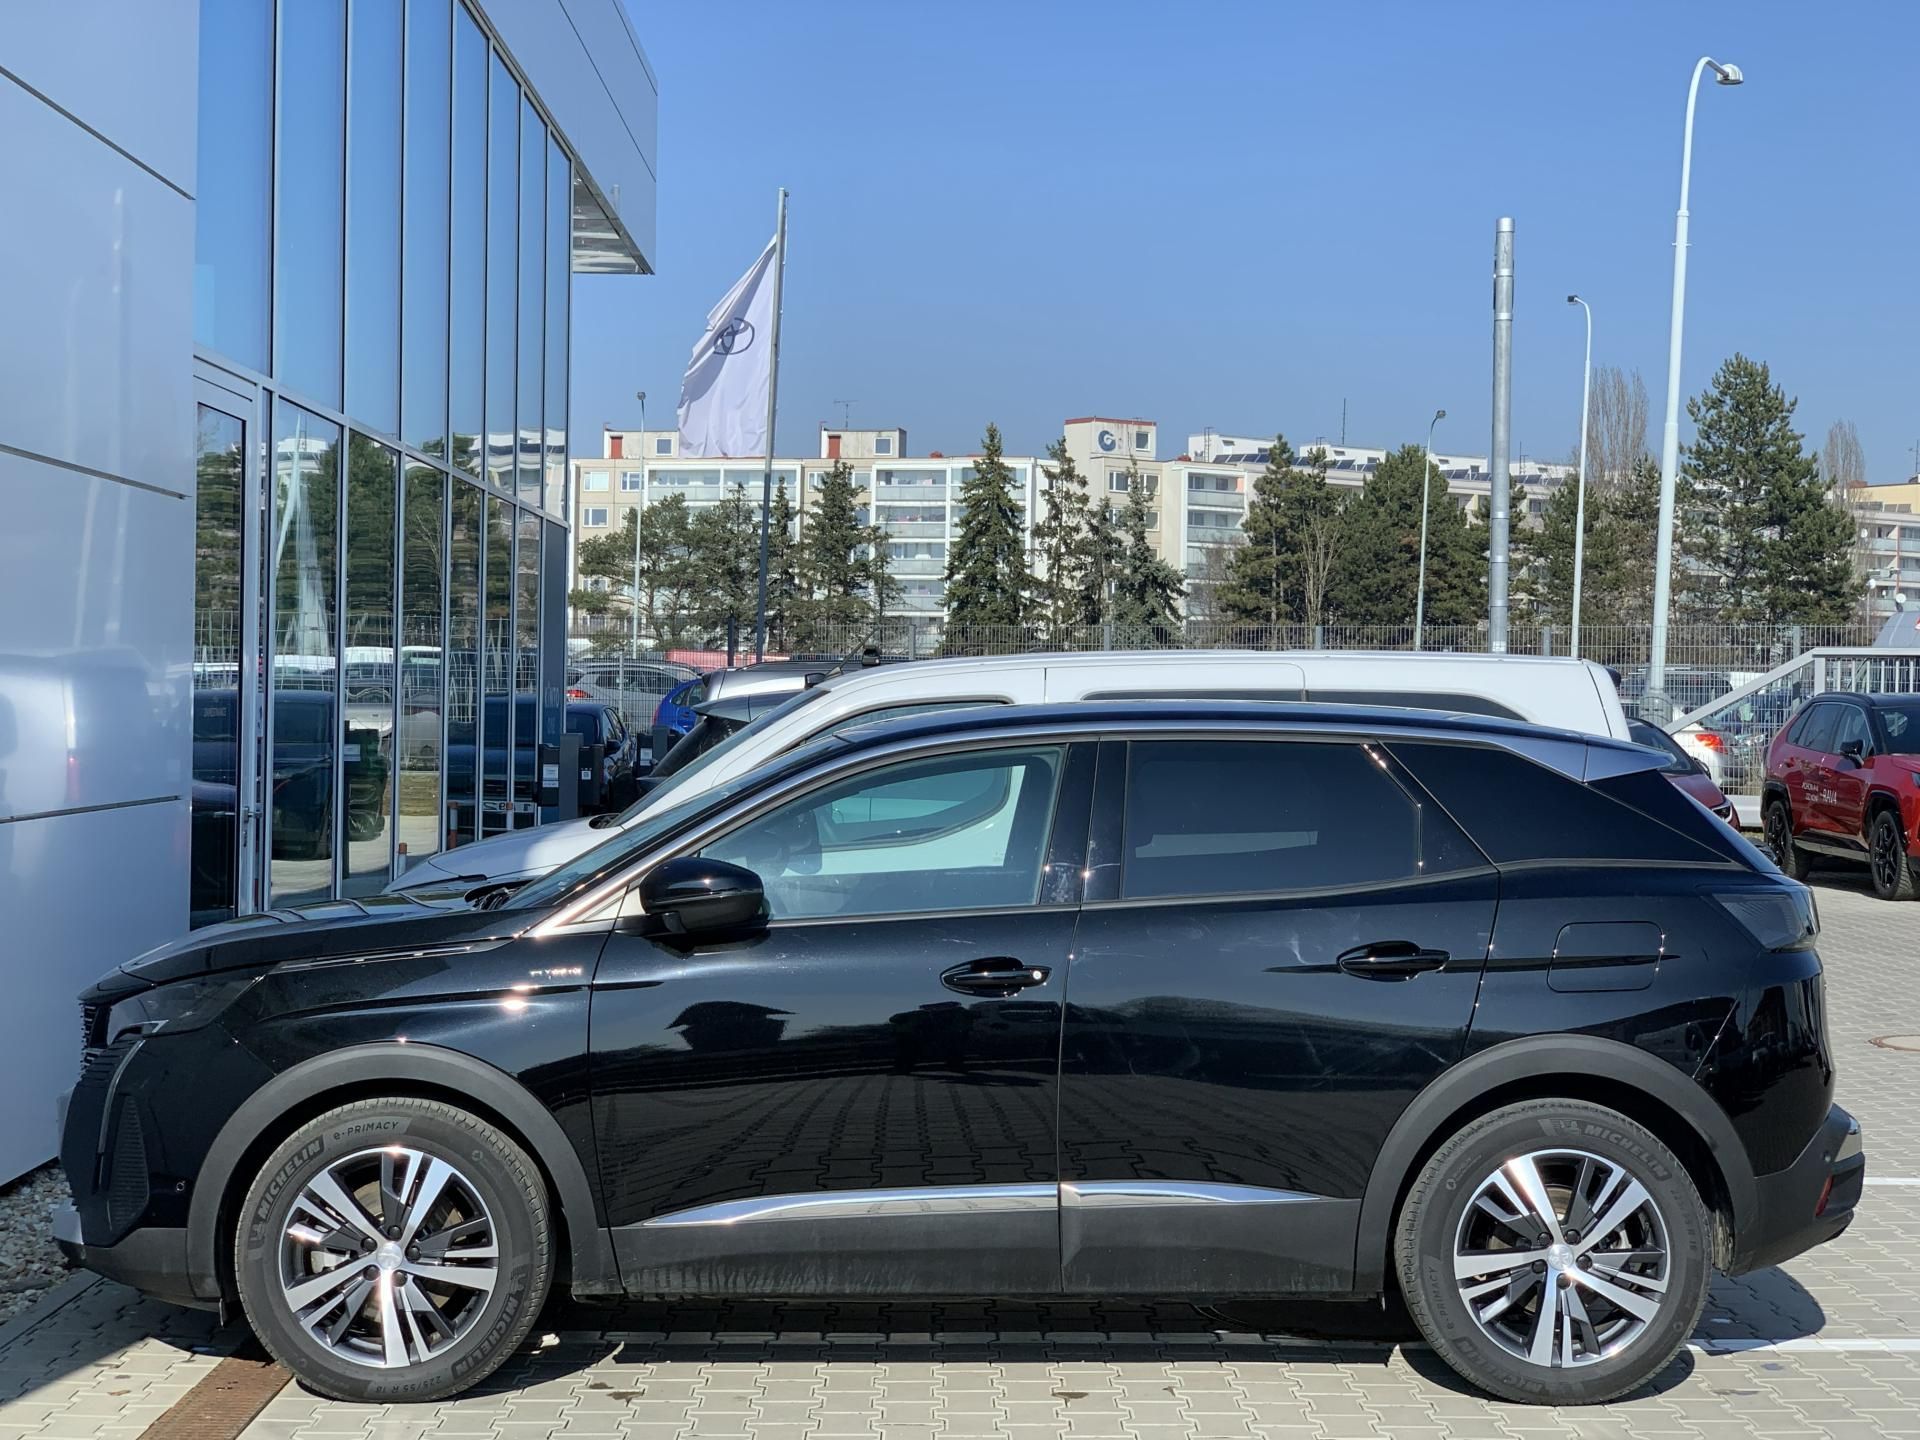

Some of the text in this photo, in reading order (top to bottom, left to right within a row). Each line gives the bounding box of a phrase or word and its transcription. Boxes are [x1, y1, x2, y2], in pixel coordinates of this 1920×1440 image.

[257, 1138, 322, 1221] MICHELIN
[1584, 1124, 1669, 1179] MICHELIN
[454, 1296, 519, 1377] MICHELIN
